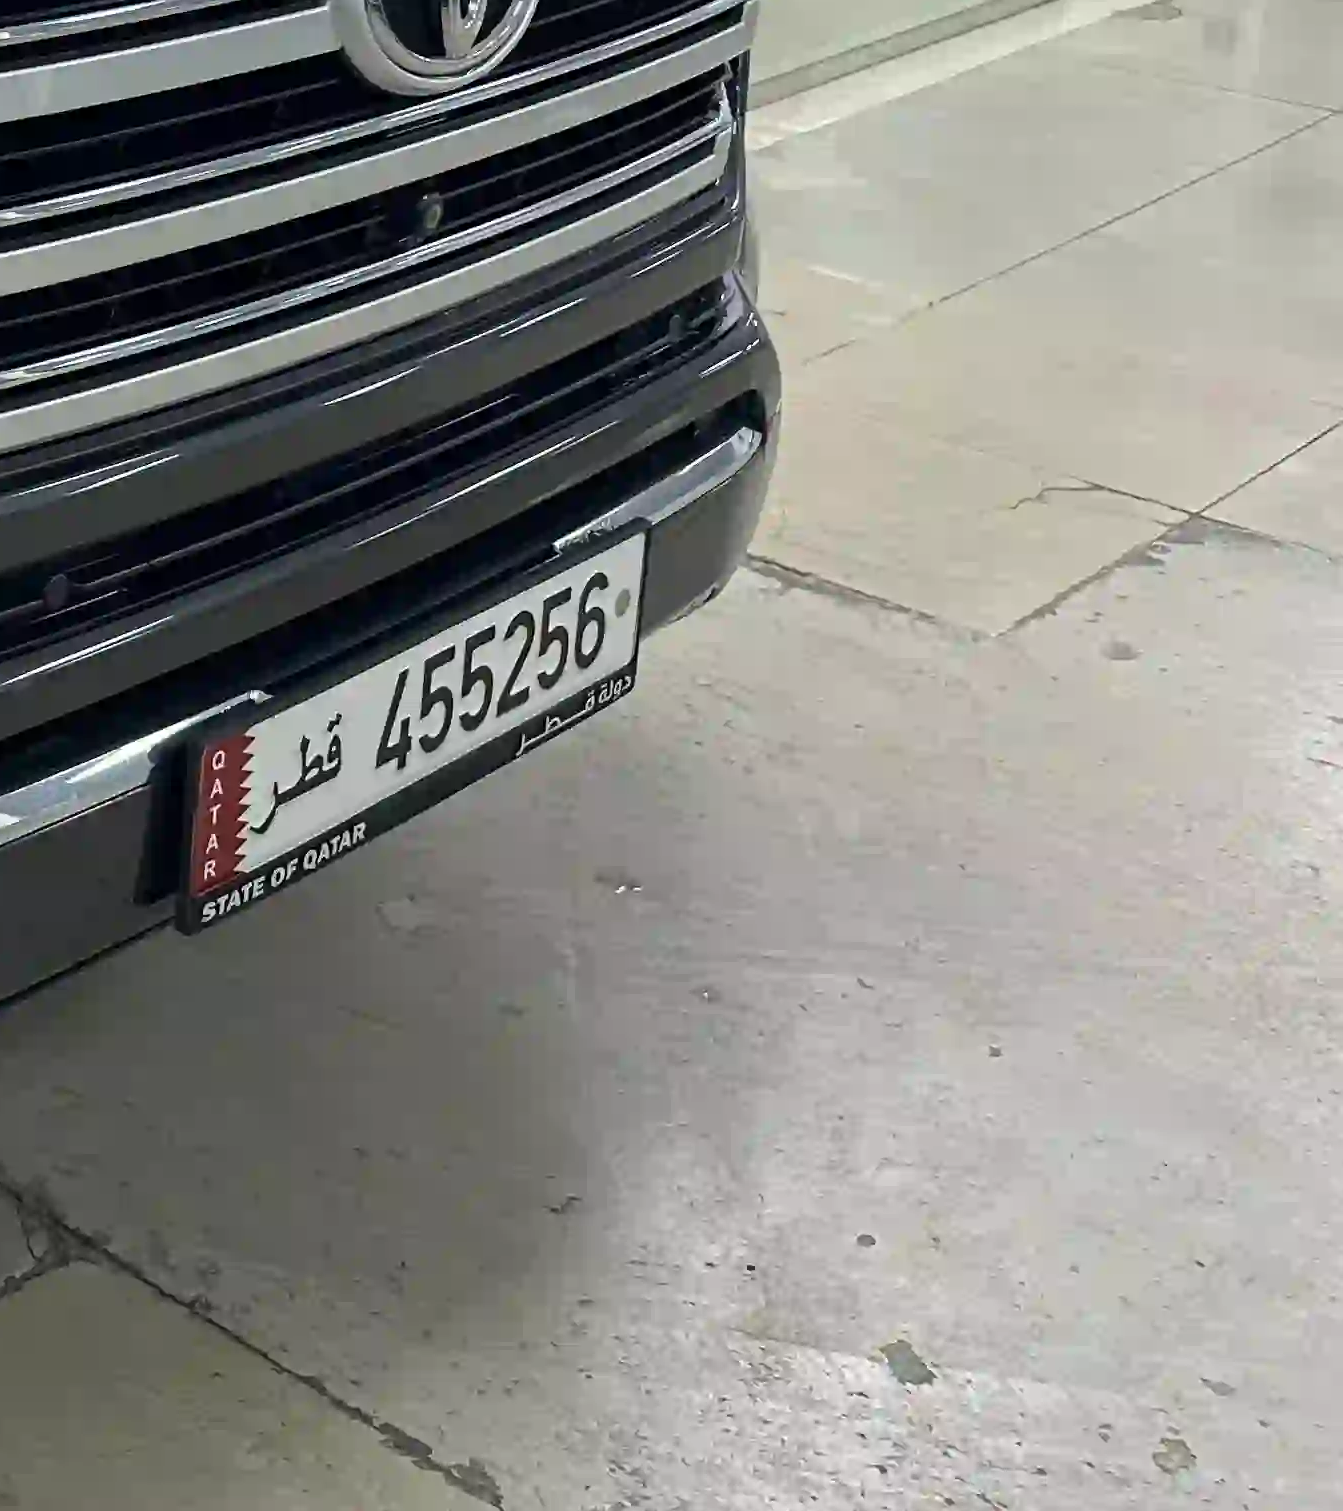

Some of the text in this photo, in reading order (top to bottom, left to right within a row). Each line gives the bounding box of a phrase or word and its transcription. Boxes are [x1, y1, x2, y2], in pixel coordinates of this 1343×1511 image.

[374, 572, 609, 771] 455256
[202, 749, 227, 880] QATAR
[249, 712, 343, 834] قطر
[201, 822, 367, 923] STATE OF QATAR
